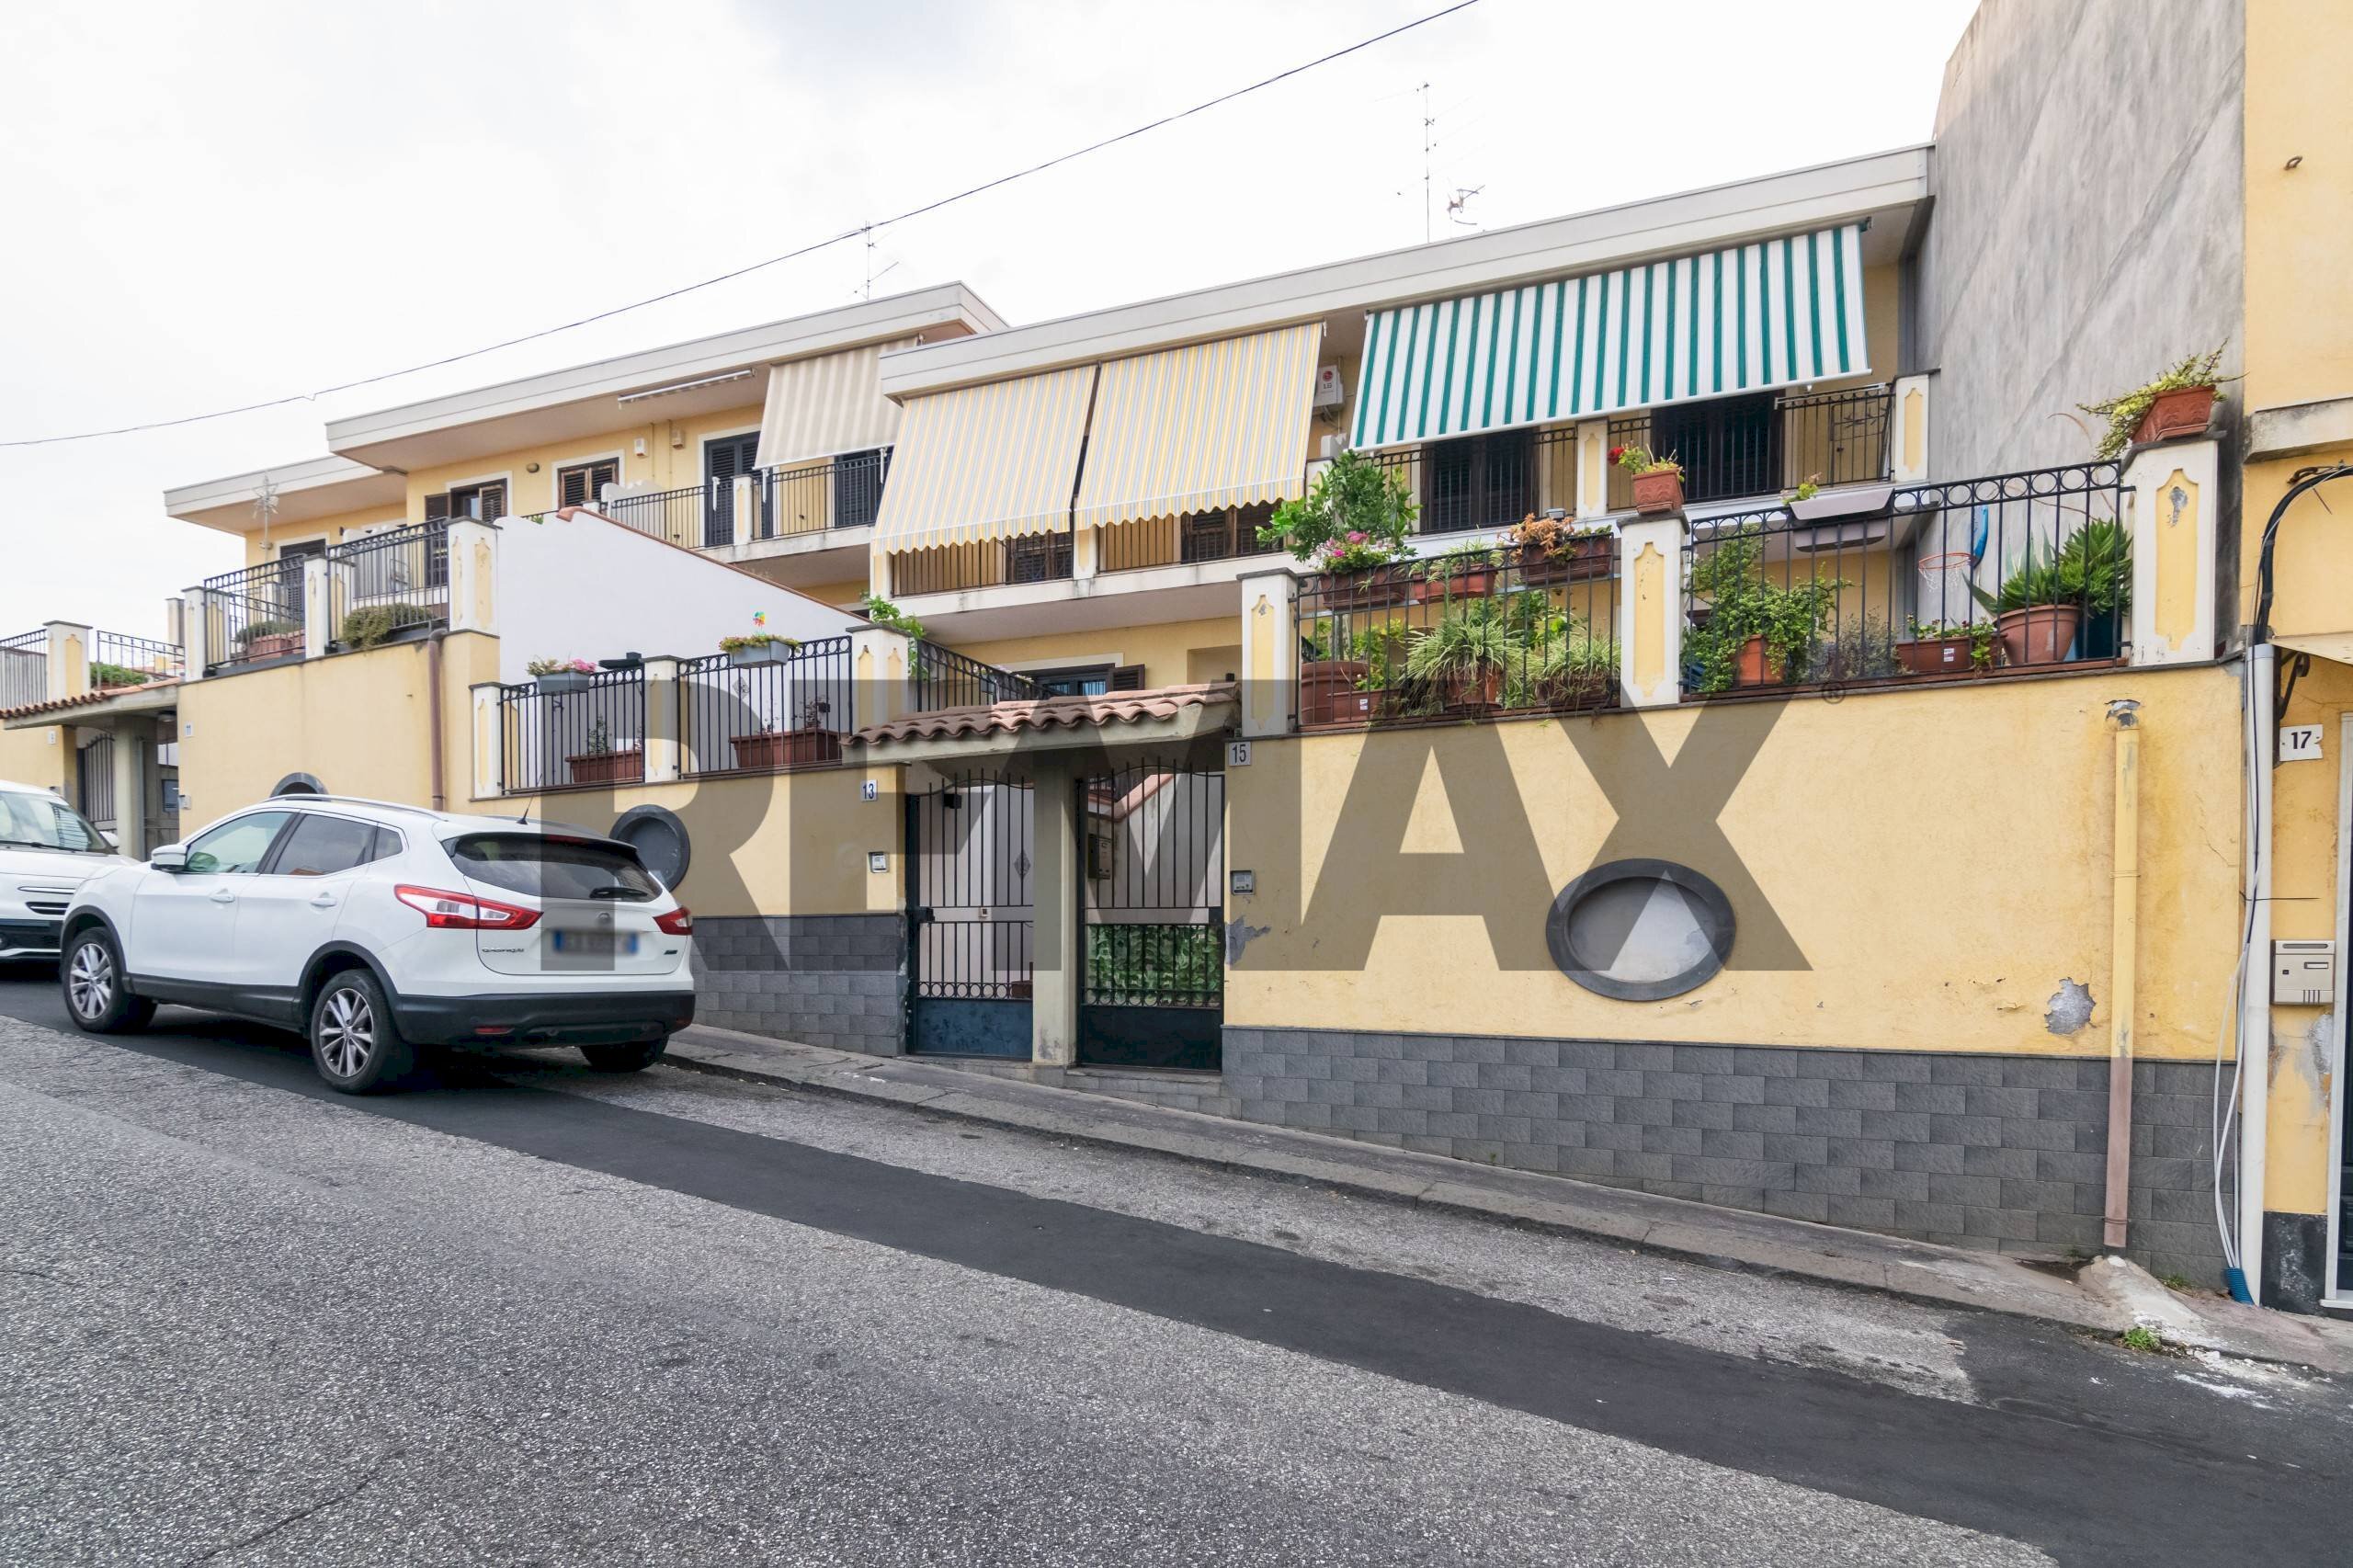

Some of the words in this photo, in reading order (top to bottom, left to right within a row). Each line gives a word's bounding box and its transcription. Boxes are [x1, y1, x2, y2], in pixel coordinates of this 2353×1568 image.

[2290, 731, 2312, 749] 17
[1232, 744, 1246, 764] 15
[862, 783, 874, 800] 13
